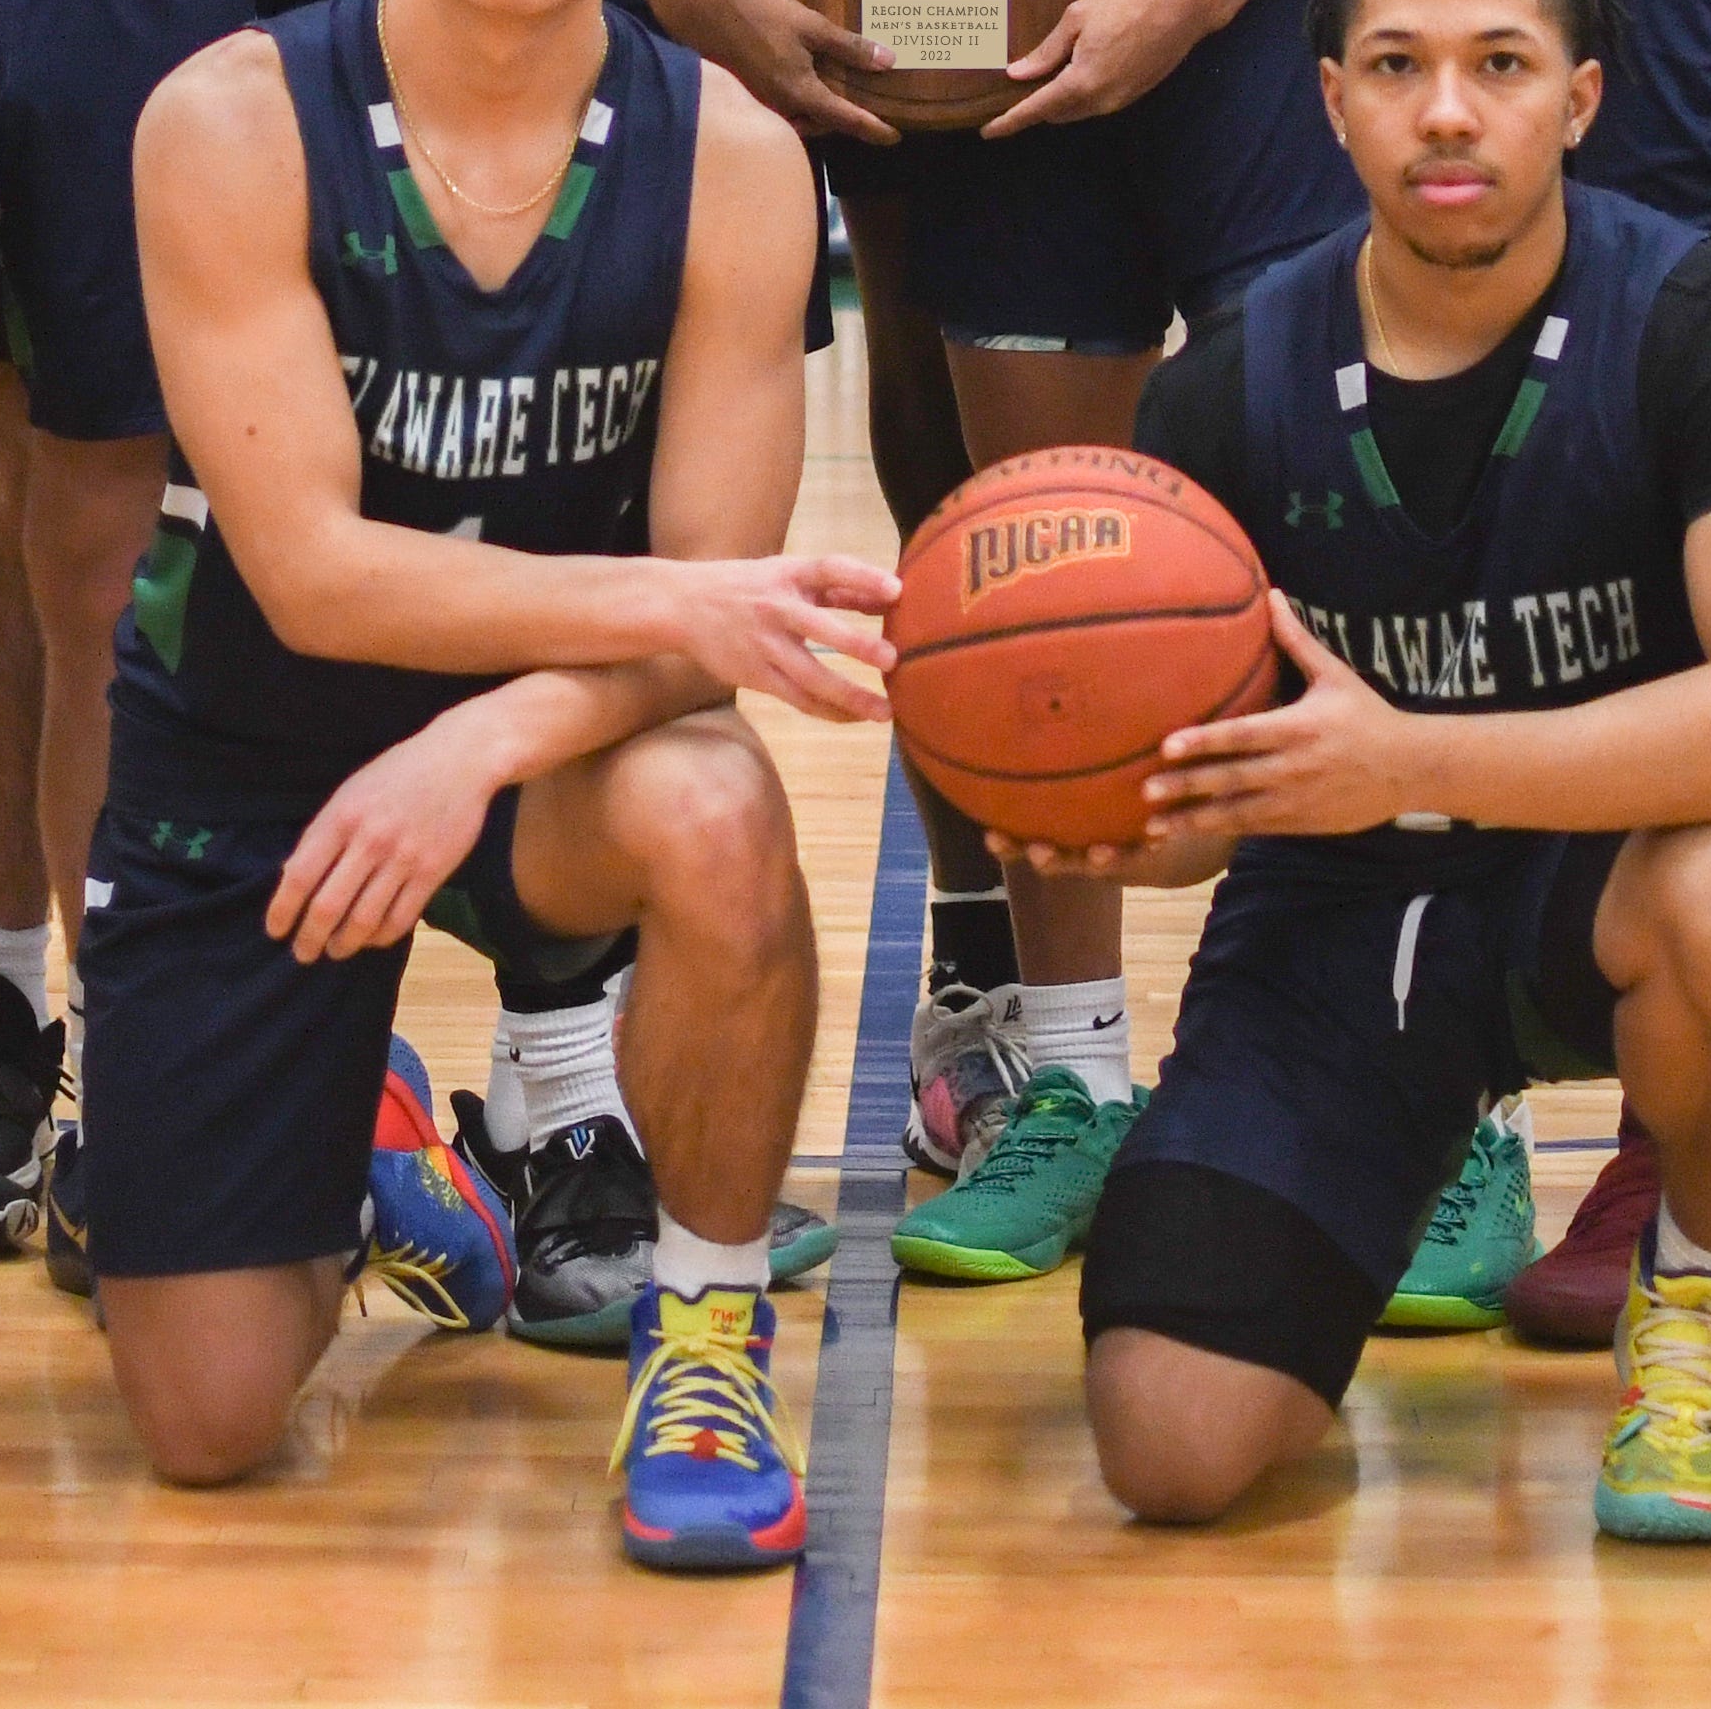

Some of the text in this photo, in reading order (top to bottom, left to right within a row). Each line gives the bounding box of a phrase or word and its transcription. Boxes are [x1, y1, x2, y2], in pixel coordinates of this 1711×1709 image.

[871, 5, 1000, 17] REGION CHAMPION
[870, 21, 1000, 31] MEN'S BASKETBALL
[891, 35, 980, 47] DIVISION II
[920, 50, 952, 62] 2022
[966, 511, 1126, 600] NJCAA
[1512, 578, 1644, 689] TECH
